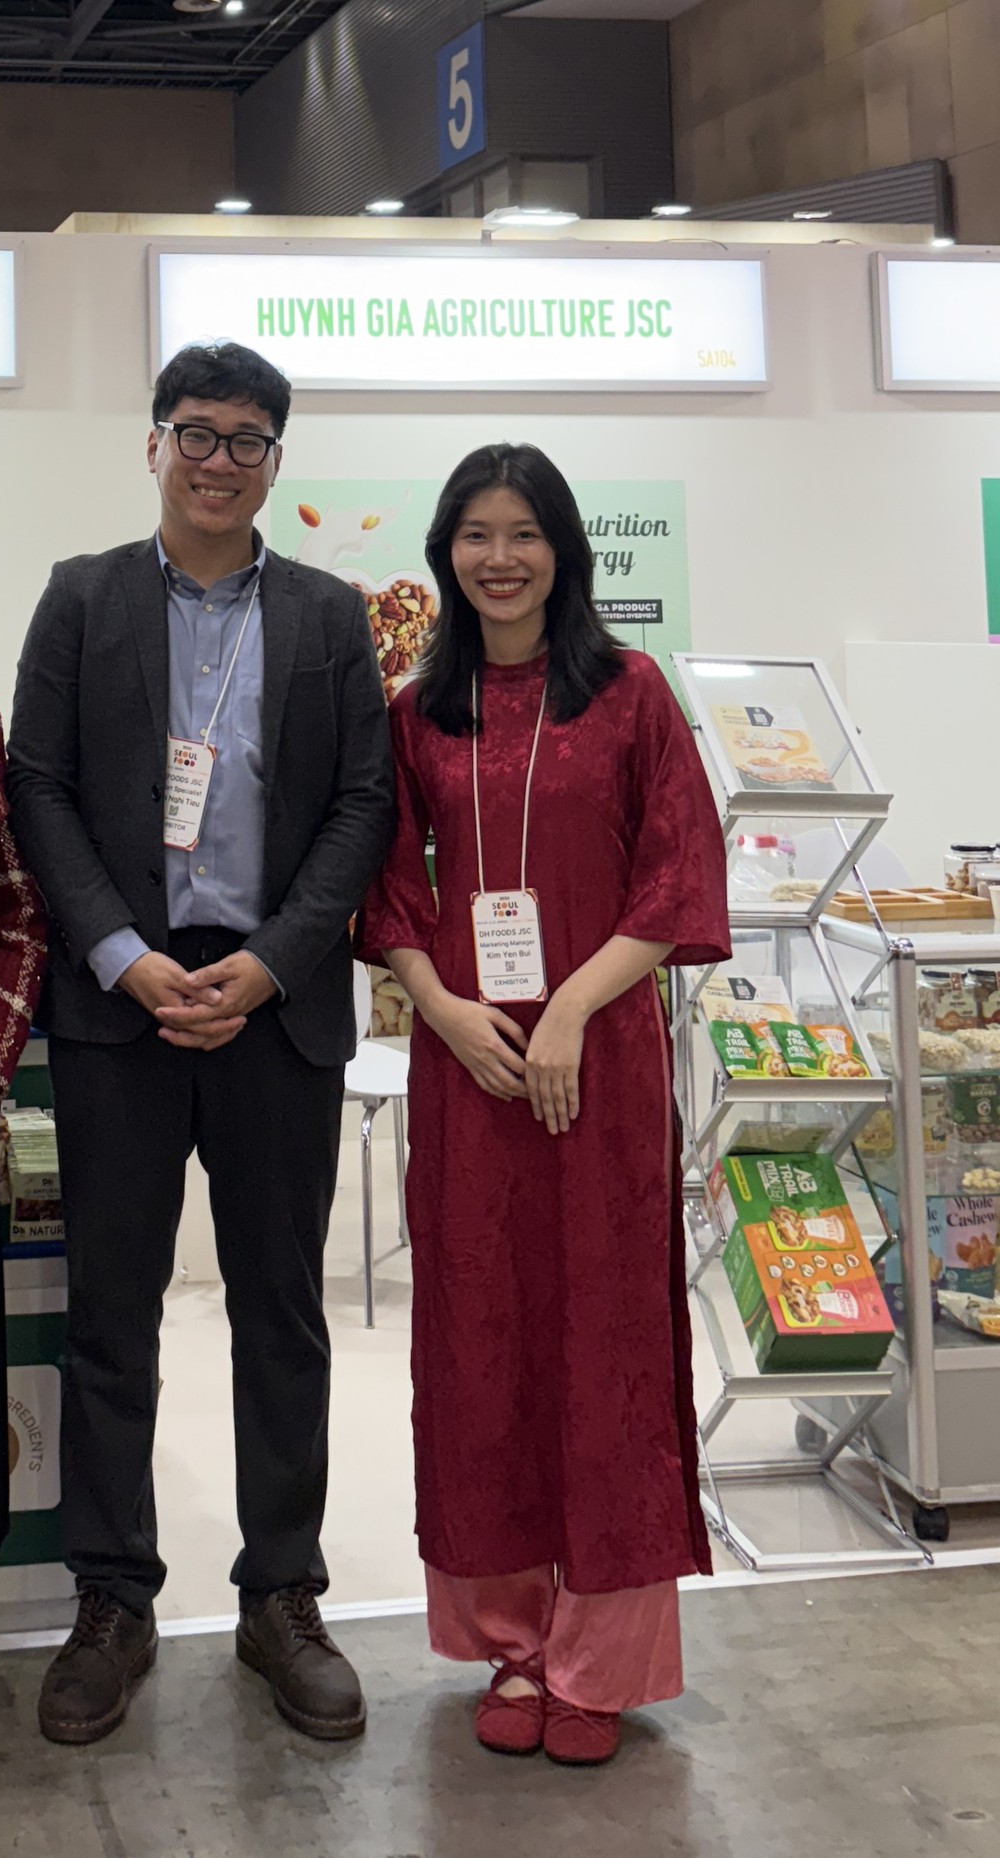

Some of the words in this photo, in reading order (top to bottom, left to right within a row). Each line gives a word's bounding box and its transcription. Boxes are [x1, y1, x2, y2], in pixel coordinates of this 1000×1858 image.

[448, 48, 473, 150] 5
[257, 297, 355, 337] HUYNH
[366, 297, 415, 337] GIA
[422, 298, 616, 338] AGRICULTURE
[624, 299, 673, 338] JSC
[697, 350, 737, 368] 5A104
[583, 513, 670, 537] utrition
[612, 603, 658, 611] PRODUCT
[479, 930, 490, 938] DH
[491, 928, 516, 937] FOODS
[518, 927, 532, 935] JSC
[480, 940, 509, 948] Marketing
[487, 951, 501, 959] Kim
[503, 950, 517, 958] Yen
[494, 978, 529, 986] EXHIBITOR
[778, 1164, 799, 1197] TRAIL
[30, 1225, 63, 1236] NATUR
[6, 1396, 43, 1473] GREDIENTS
